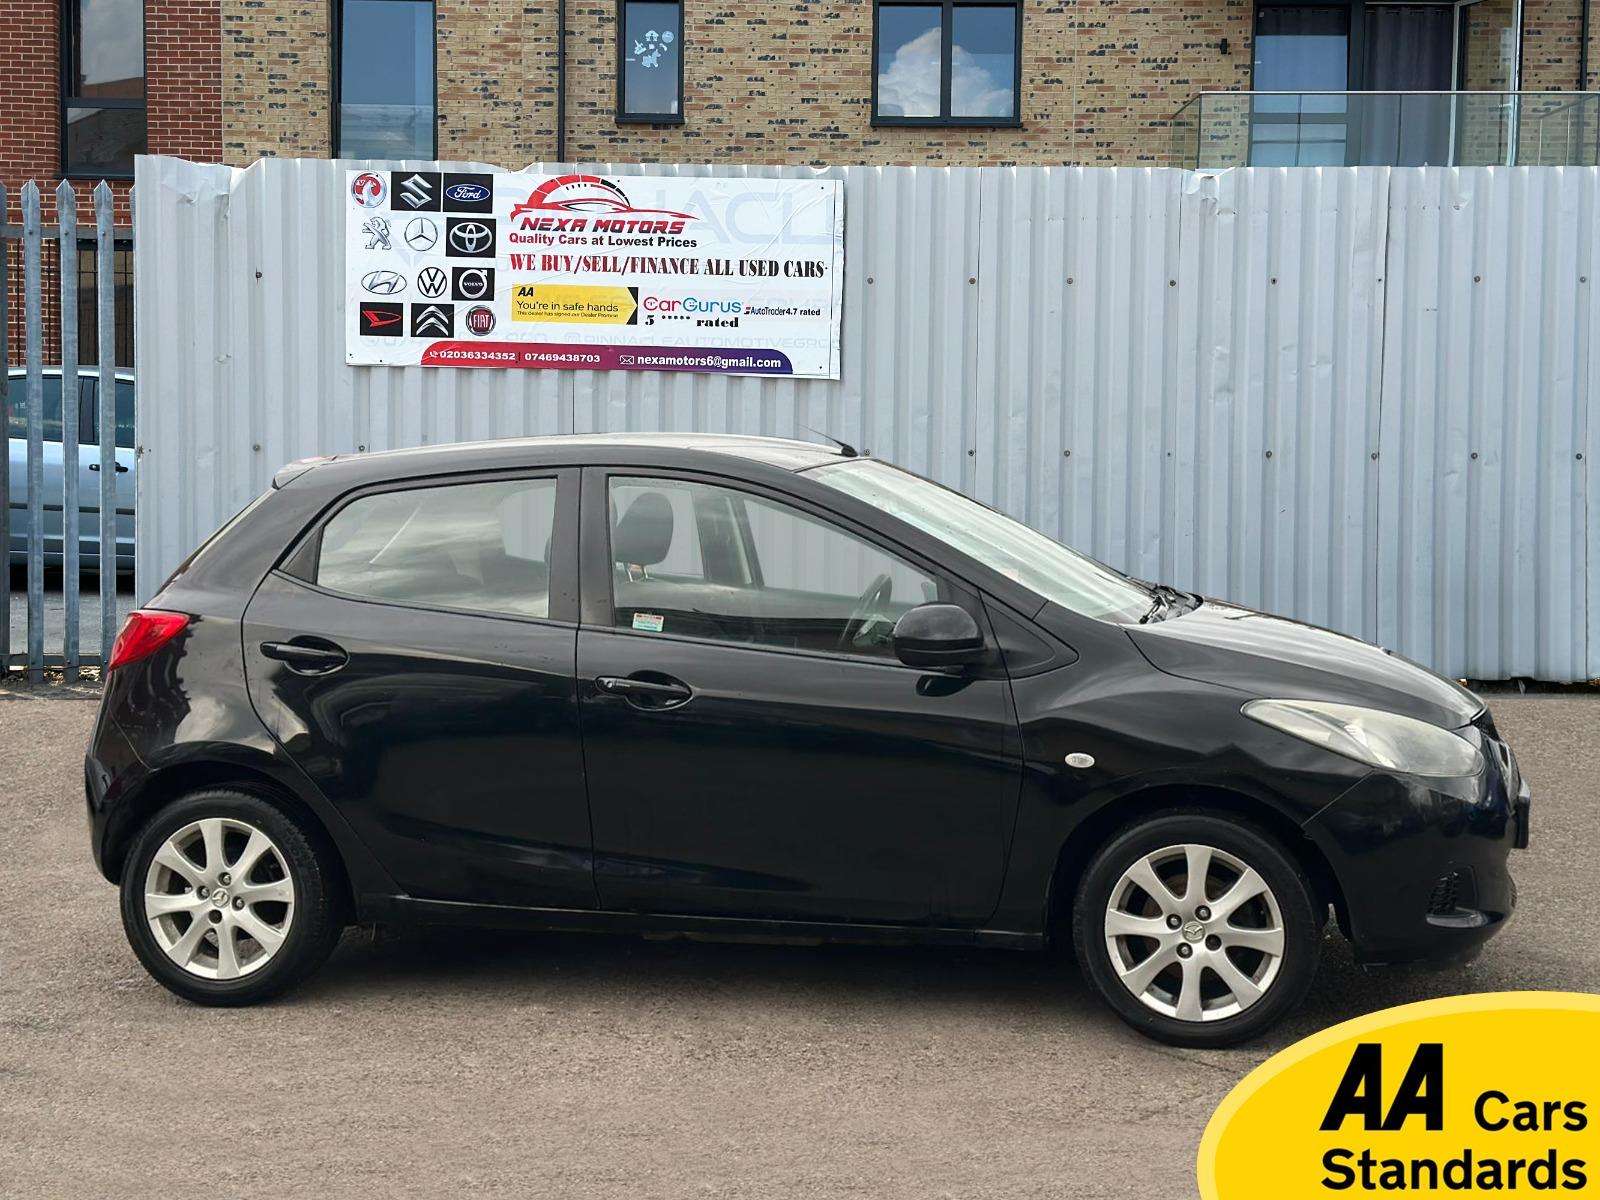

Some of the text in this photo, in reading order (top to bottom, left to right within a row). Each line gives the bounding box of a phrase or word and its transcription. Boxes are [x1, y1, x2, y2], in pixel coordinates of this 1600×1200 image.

[454, 186, 481, 200] Ford
[520, 217, 686, 235] NEXA MOTORS
[509, 232, 697, 248] Quality Cars at Lowest Prices
[509, 253, 536, 271] WE
[703, 258, 734, 276] ALL
[739, 259, 779, 277] USED
[783, 260, 825, 278] CARS
[517, 286, 534, 297] AA
[516, 300, 619, 312] You're in safe hands
[643, 296, 742, 313] CarGurus
[799, 308, 821, 316] rated
[473, 314, 490, 328] FIAT
[645, 315, 739, 328] 5 rated
[439, 351, 601, 362] 02036334352 07469438703
[637, 355, 782, 369] nexamotors6@gmail.com
